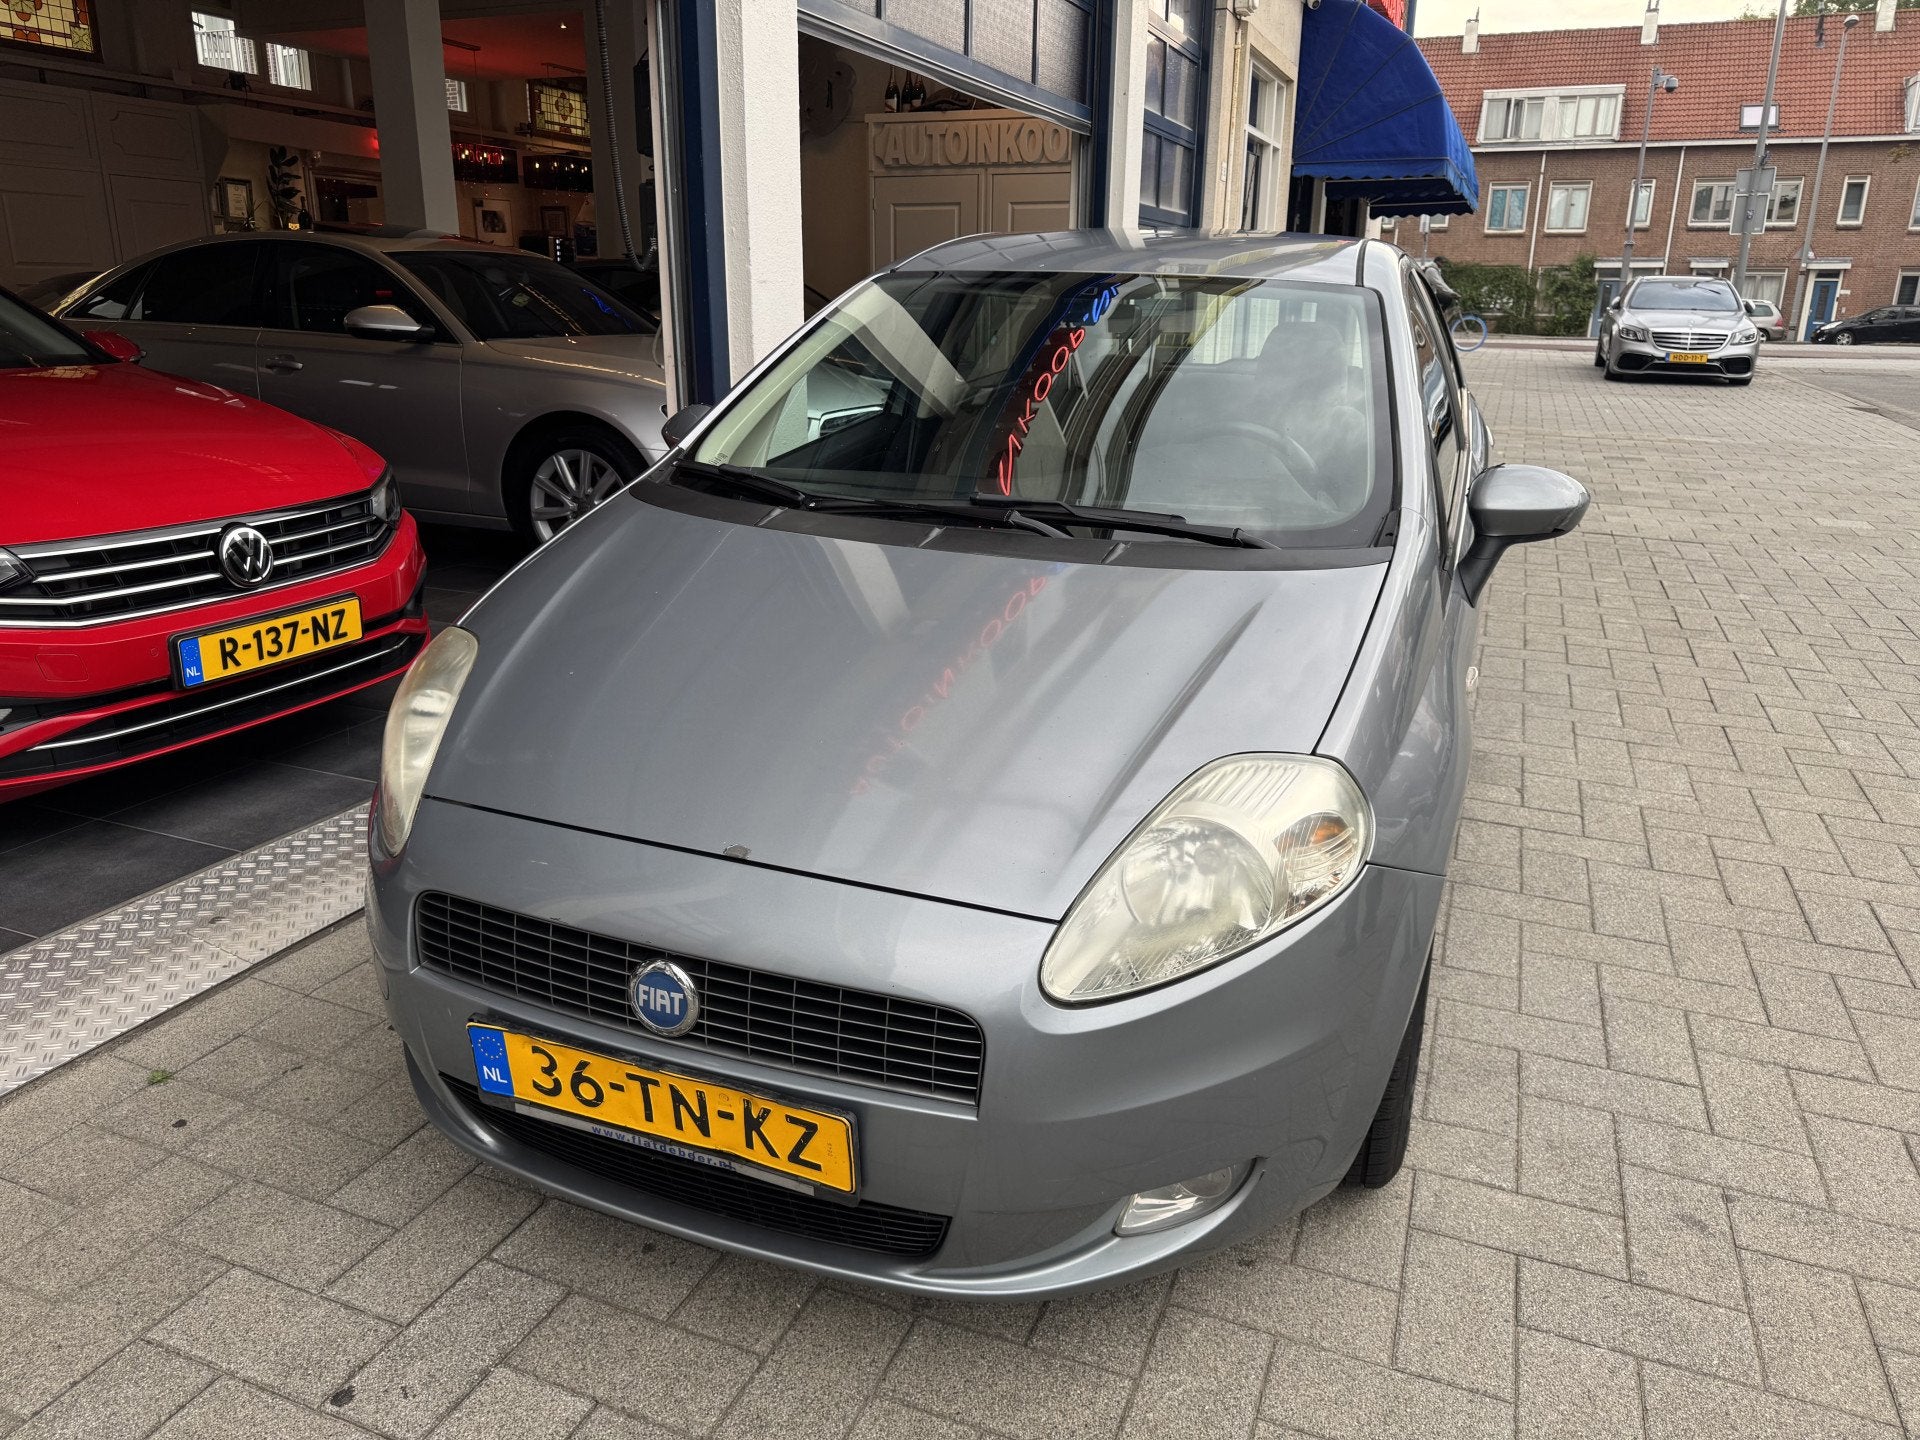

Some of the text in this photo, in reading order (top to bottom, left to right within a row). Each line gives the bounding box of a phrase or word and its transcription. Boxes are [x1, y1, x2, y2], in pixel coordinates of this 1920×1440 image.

[883, 121, 1072, 166] AUTOINKOO
[219, 608, 348, 671] R-137-NZ
[186, 666, 201, 678] NL
[638, 983, 684, 1016] FIAT
[482, 1065, 508, 1084] NL
[531, 1045, 823, 1172] 36-TN-KZ
[591, 1125, 737, 1172] www.fiatdeboer.nl
